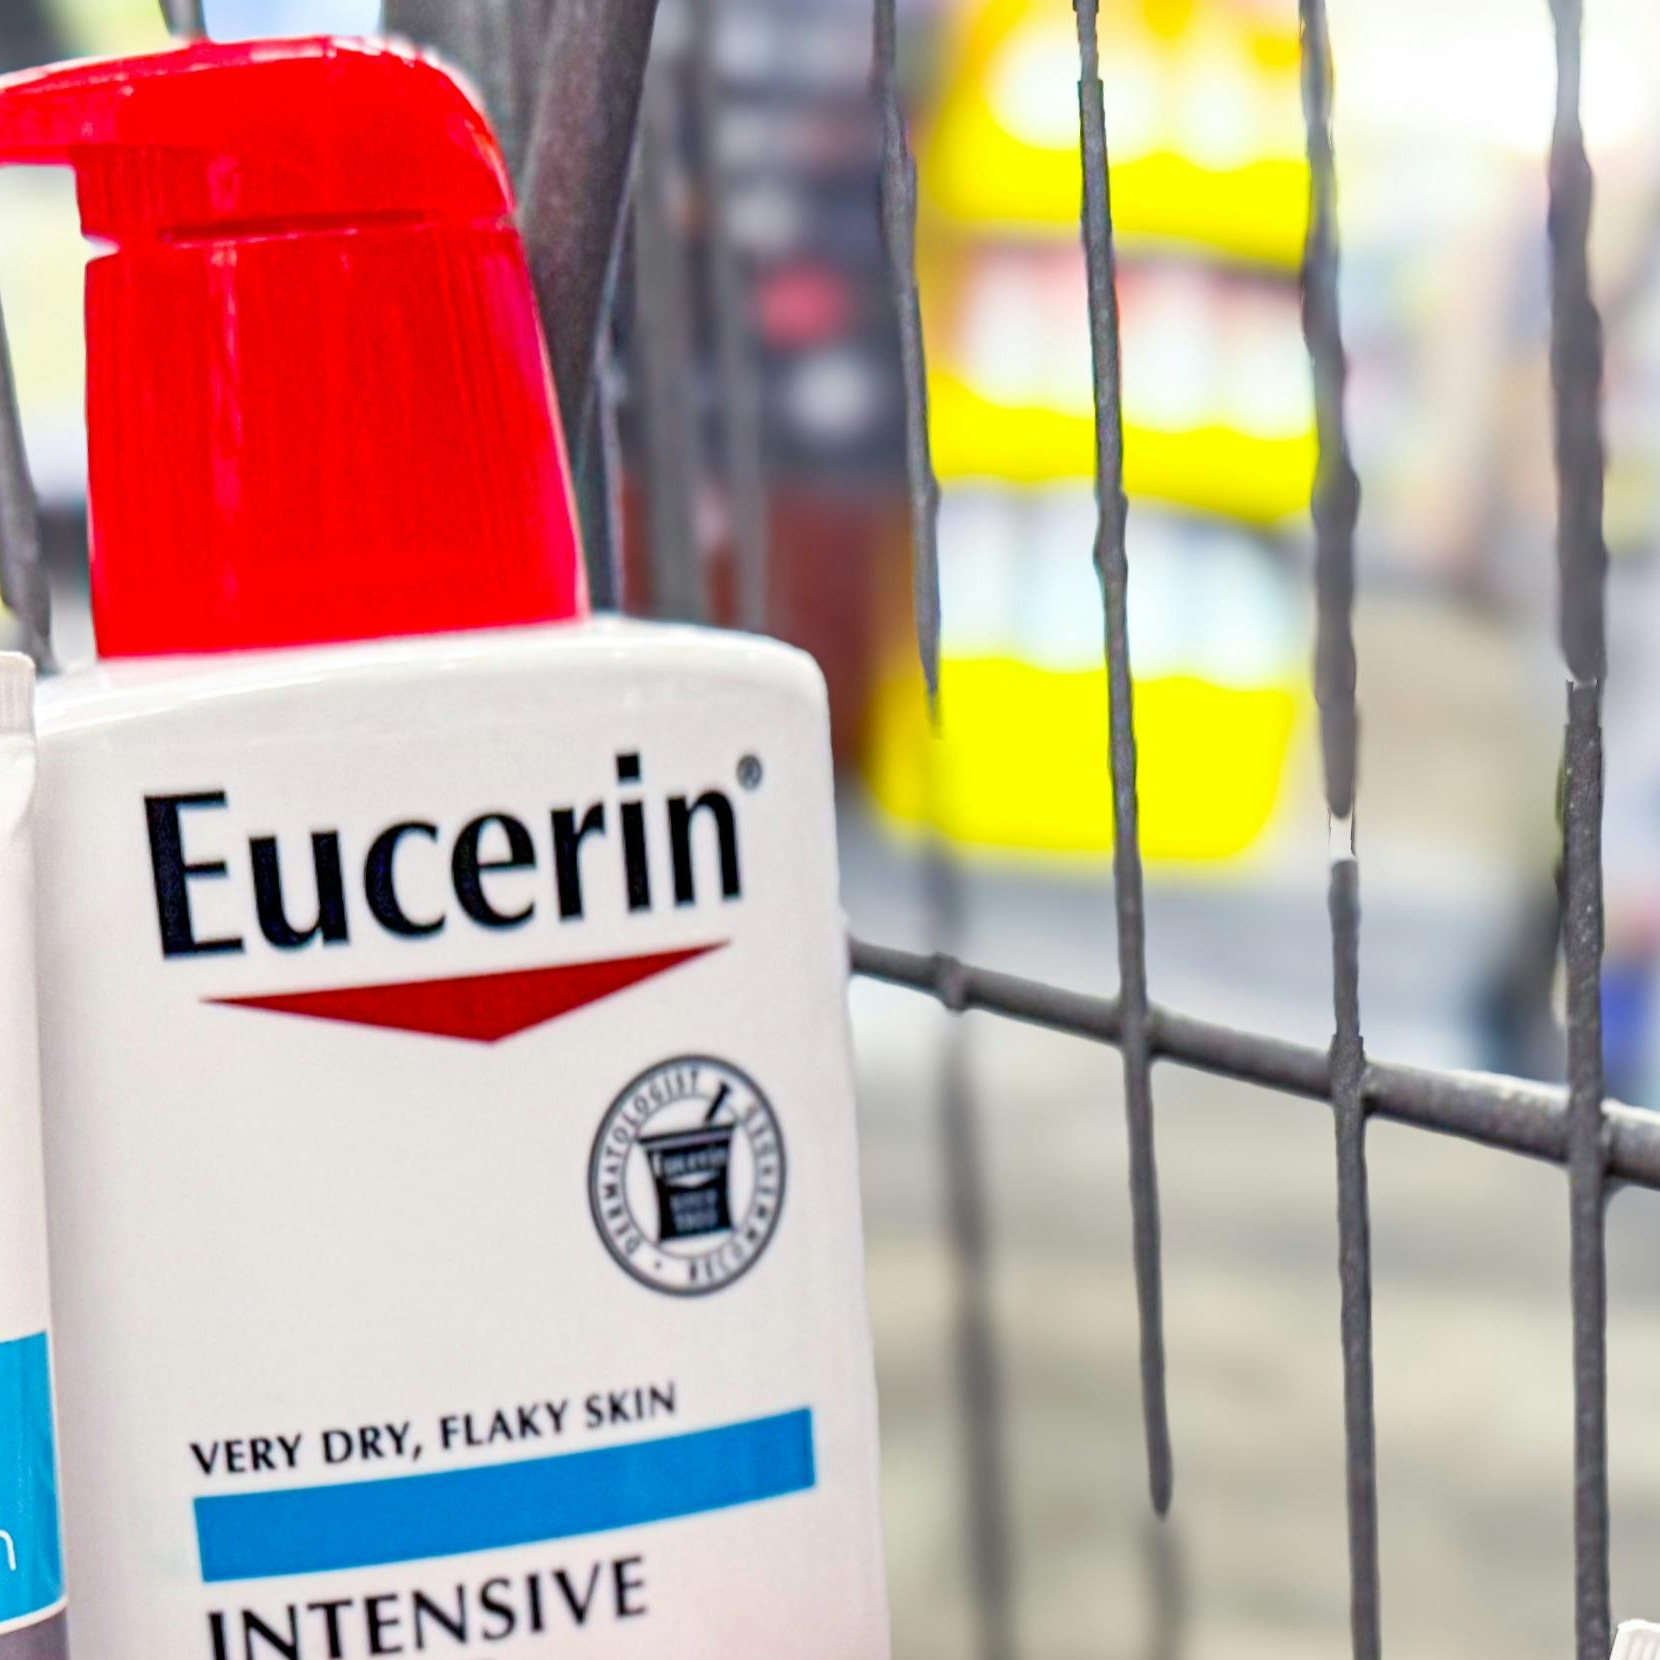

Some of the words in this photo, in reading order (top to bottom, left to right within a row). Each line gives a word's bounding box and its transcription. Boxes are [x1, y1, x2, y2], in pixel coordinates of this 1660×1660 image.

[190, 1435, 303, 1476] VERY
[322, 1423, 424, 1465] DRY,
[441, 1400, 570, 1450] FLAKY
[585, 1382, 677, 1428] SKIN
